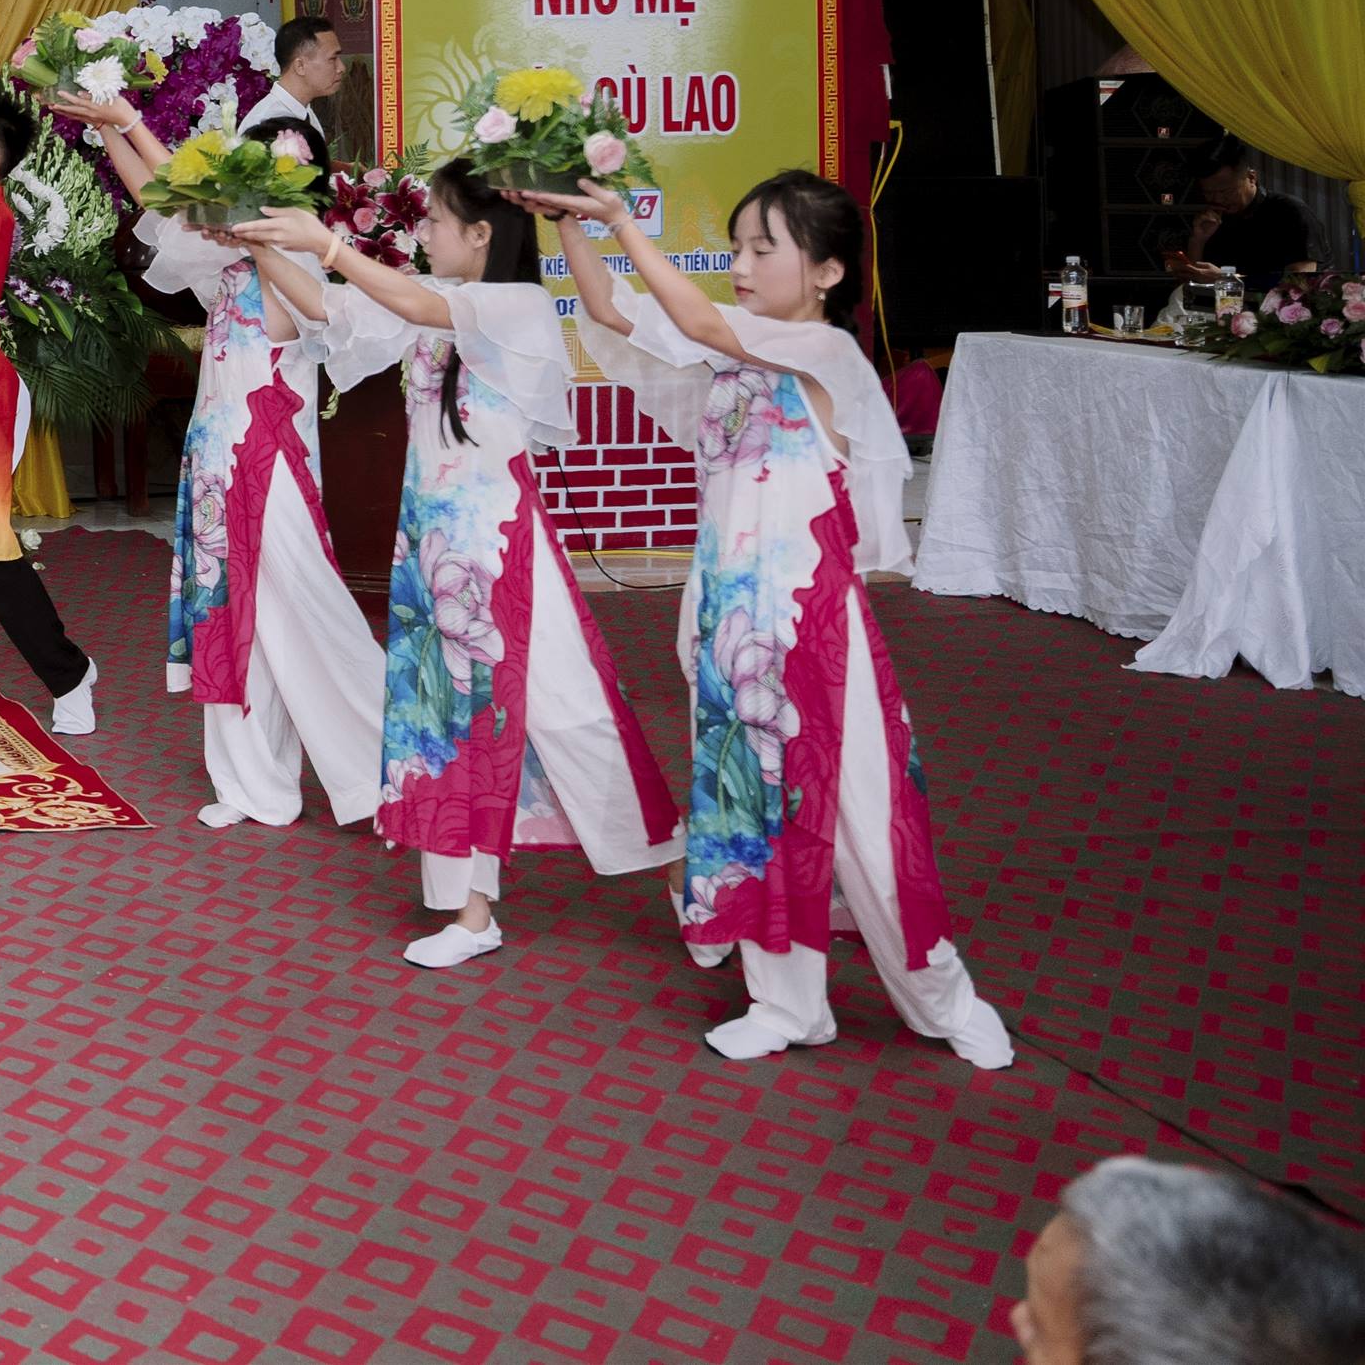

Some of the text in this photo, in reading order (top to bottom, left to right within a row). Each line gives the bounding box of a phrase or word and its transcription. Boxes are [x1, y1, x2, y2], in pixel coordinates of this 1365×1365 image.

[662, 74, 736, 132] LAO
[684, 248, 709, 271] TIẾN
[713, 253, 734, 271] LON
